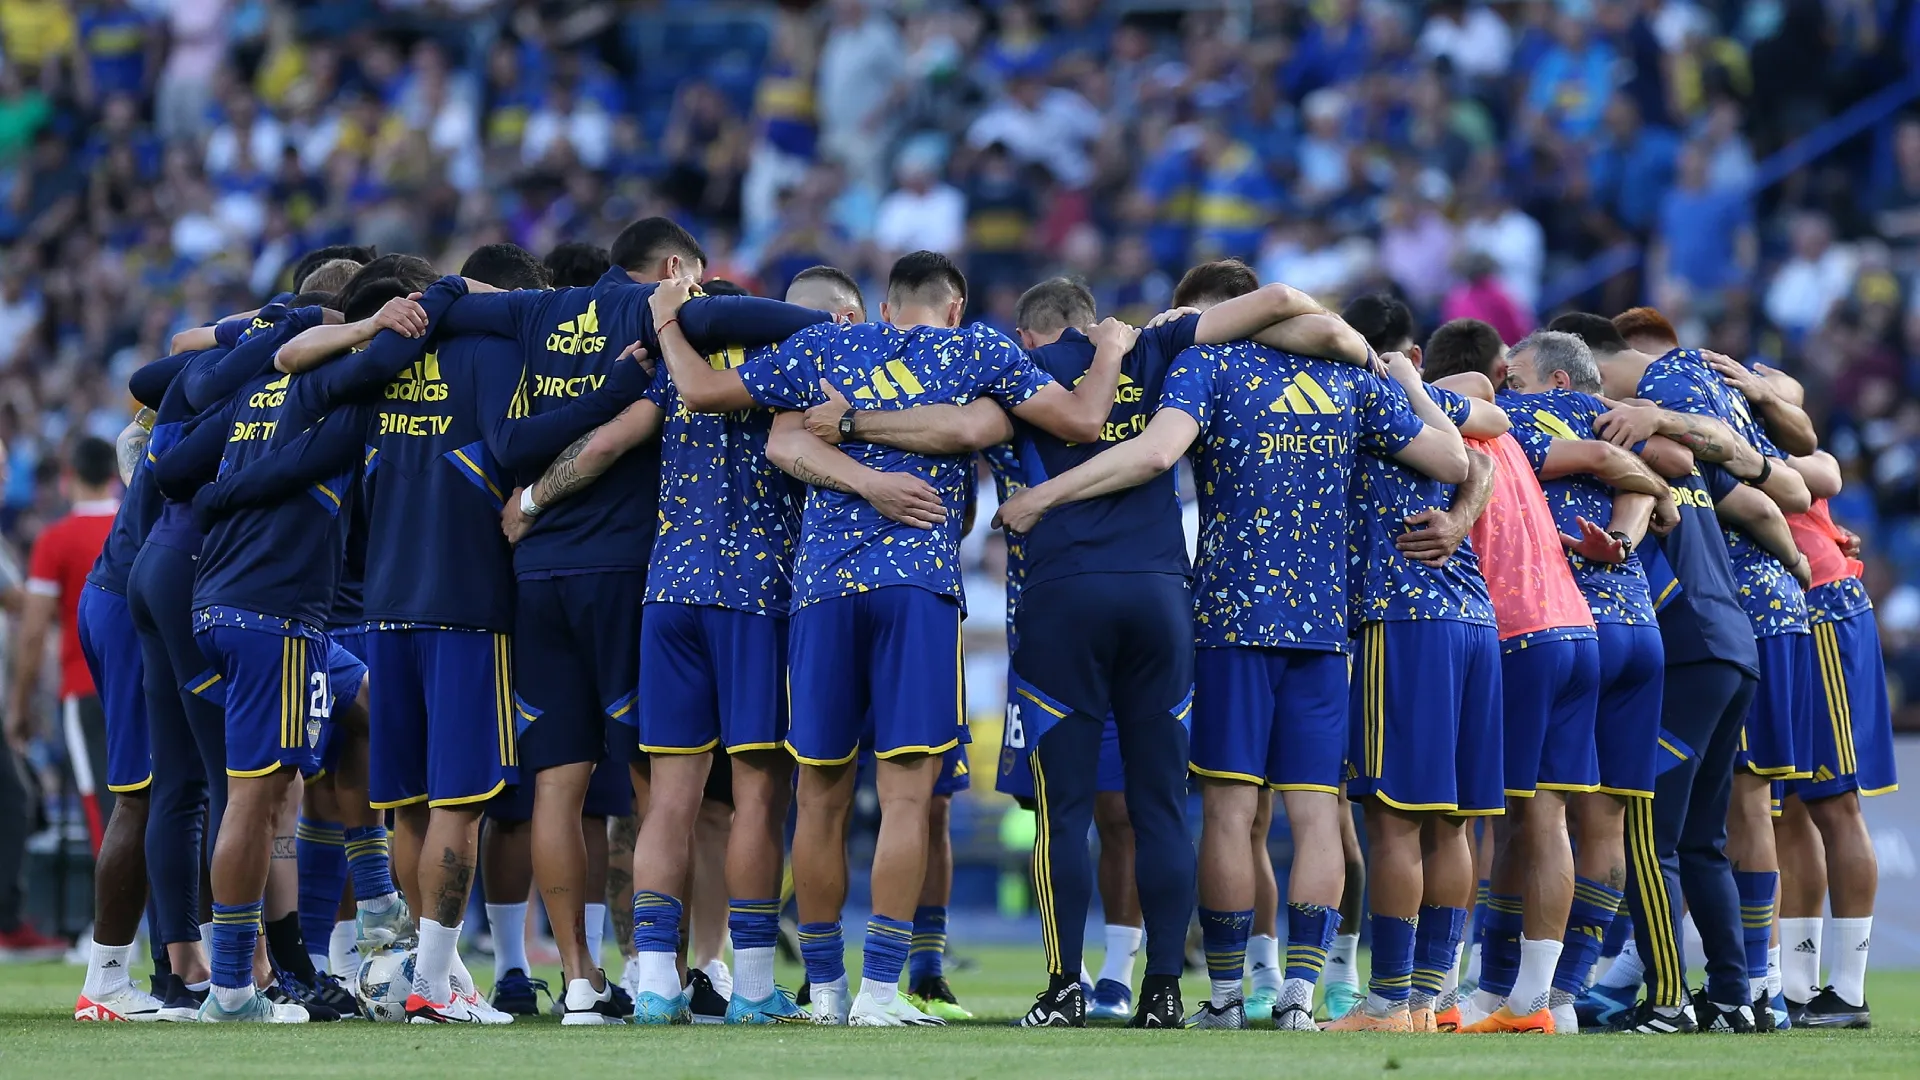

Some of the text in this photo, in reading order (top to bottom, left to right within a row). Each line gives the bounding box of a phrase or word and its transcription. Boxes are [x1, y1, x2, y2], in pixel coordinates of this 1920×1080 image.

[546, 333, 607, 356] adias
[384, 379, 449, 402] adias
[533, 374, 606, 398] DIRCTV
[1257, 432, 1348, 455] DIRECTV
[1166, 994, 1174, 1016] COPA
